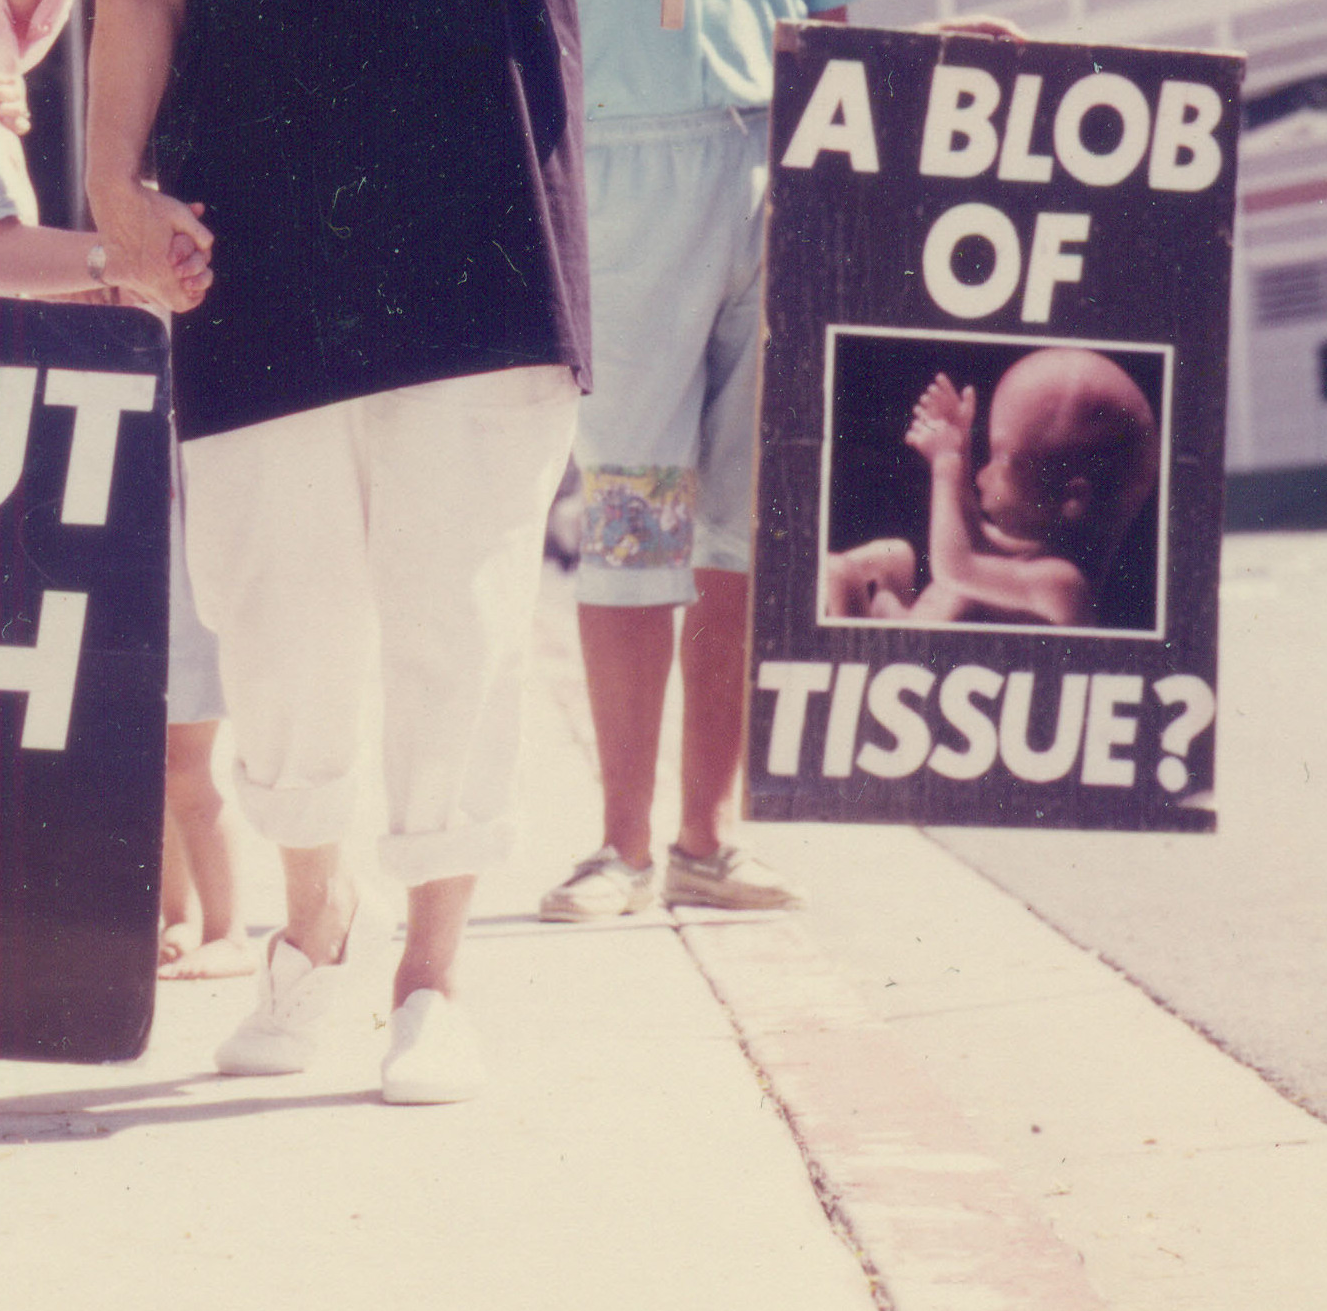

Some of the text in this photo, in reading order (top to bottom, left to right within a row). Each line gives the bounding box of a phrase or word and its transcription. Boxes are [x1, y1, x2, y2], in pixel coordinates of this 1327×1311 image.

[781, 59, 1223, 193] A BLOB
[922, 203, 1091, 323] OF
[757, 661, 1215, 794] TISSUE?
